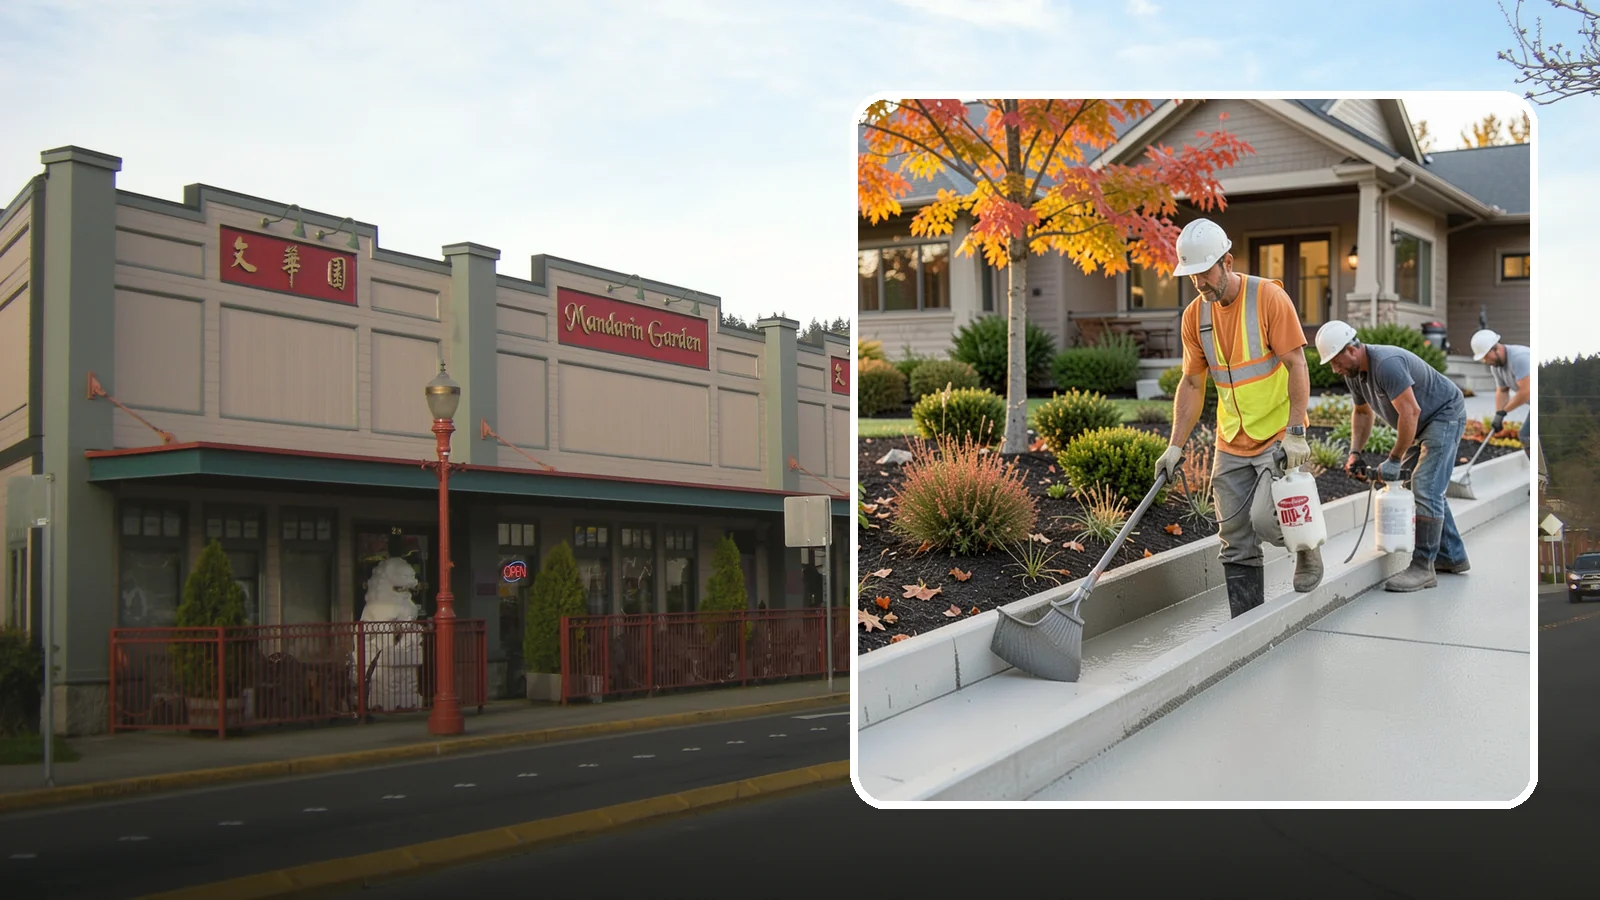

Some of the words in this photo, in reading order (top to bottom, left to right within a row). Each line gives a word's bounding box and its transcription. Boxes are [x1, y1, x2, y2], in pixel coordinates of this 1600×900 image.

[230, 235, 346, 291] 文華園
[564, 302, 644, 341] Mandarin
[647, 320, 702, 352] Garden
[503, 565, 527, 578] OPEN
